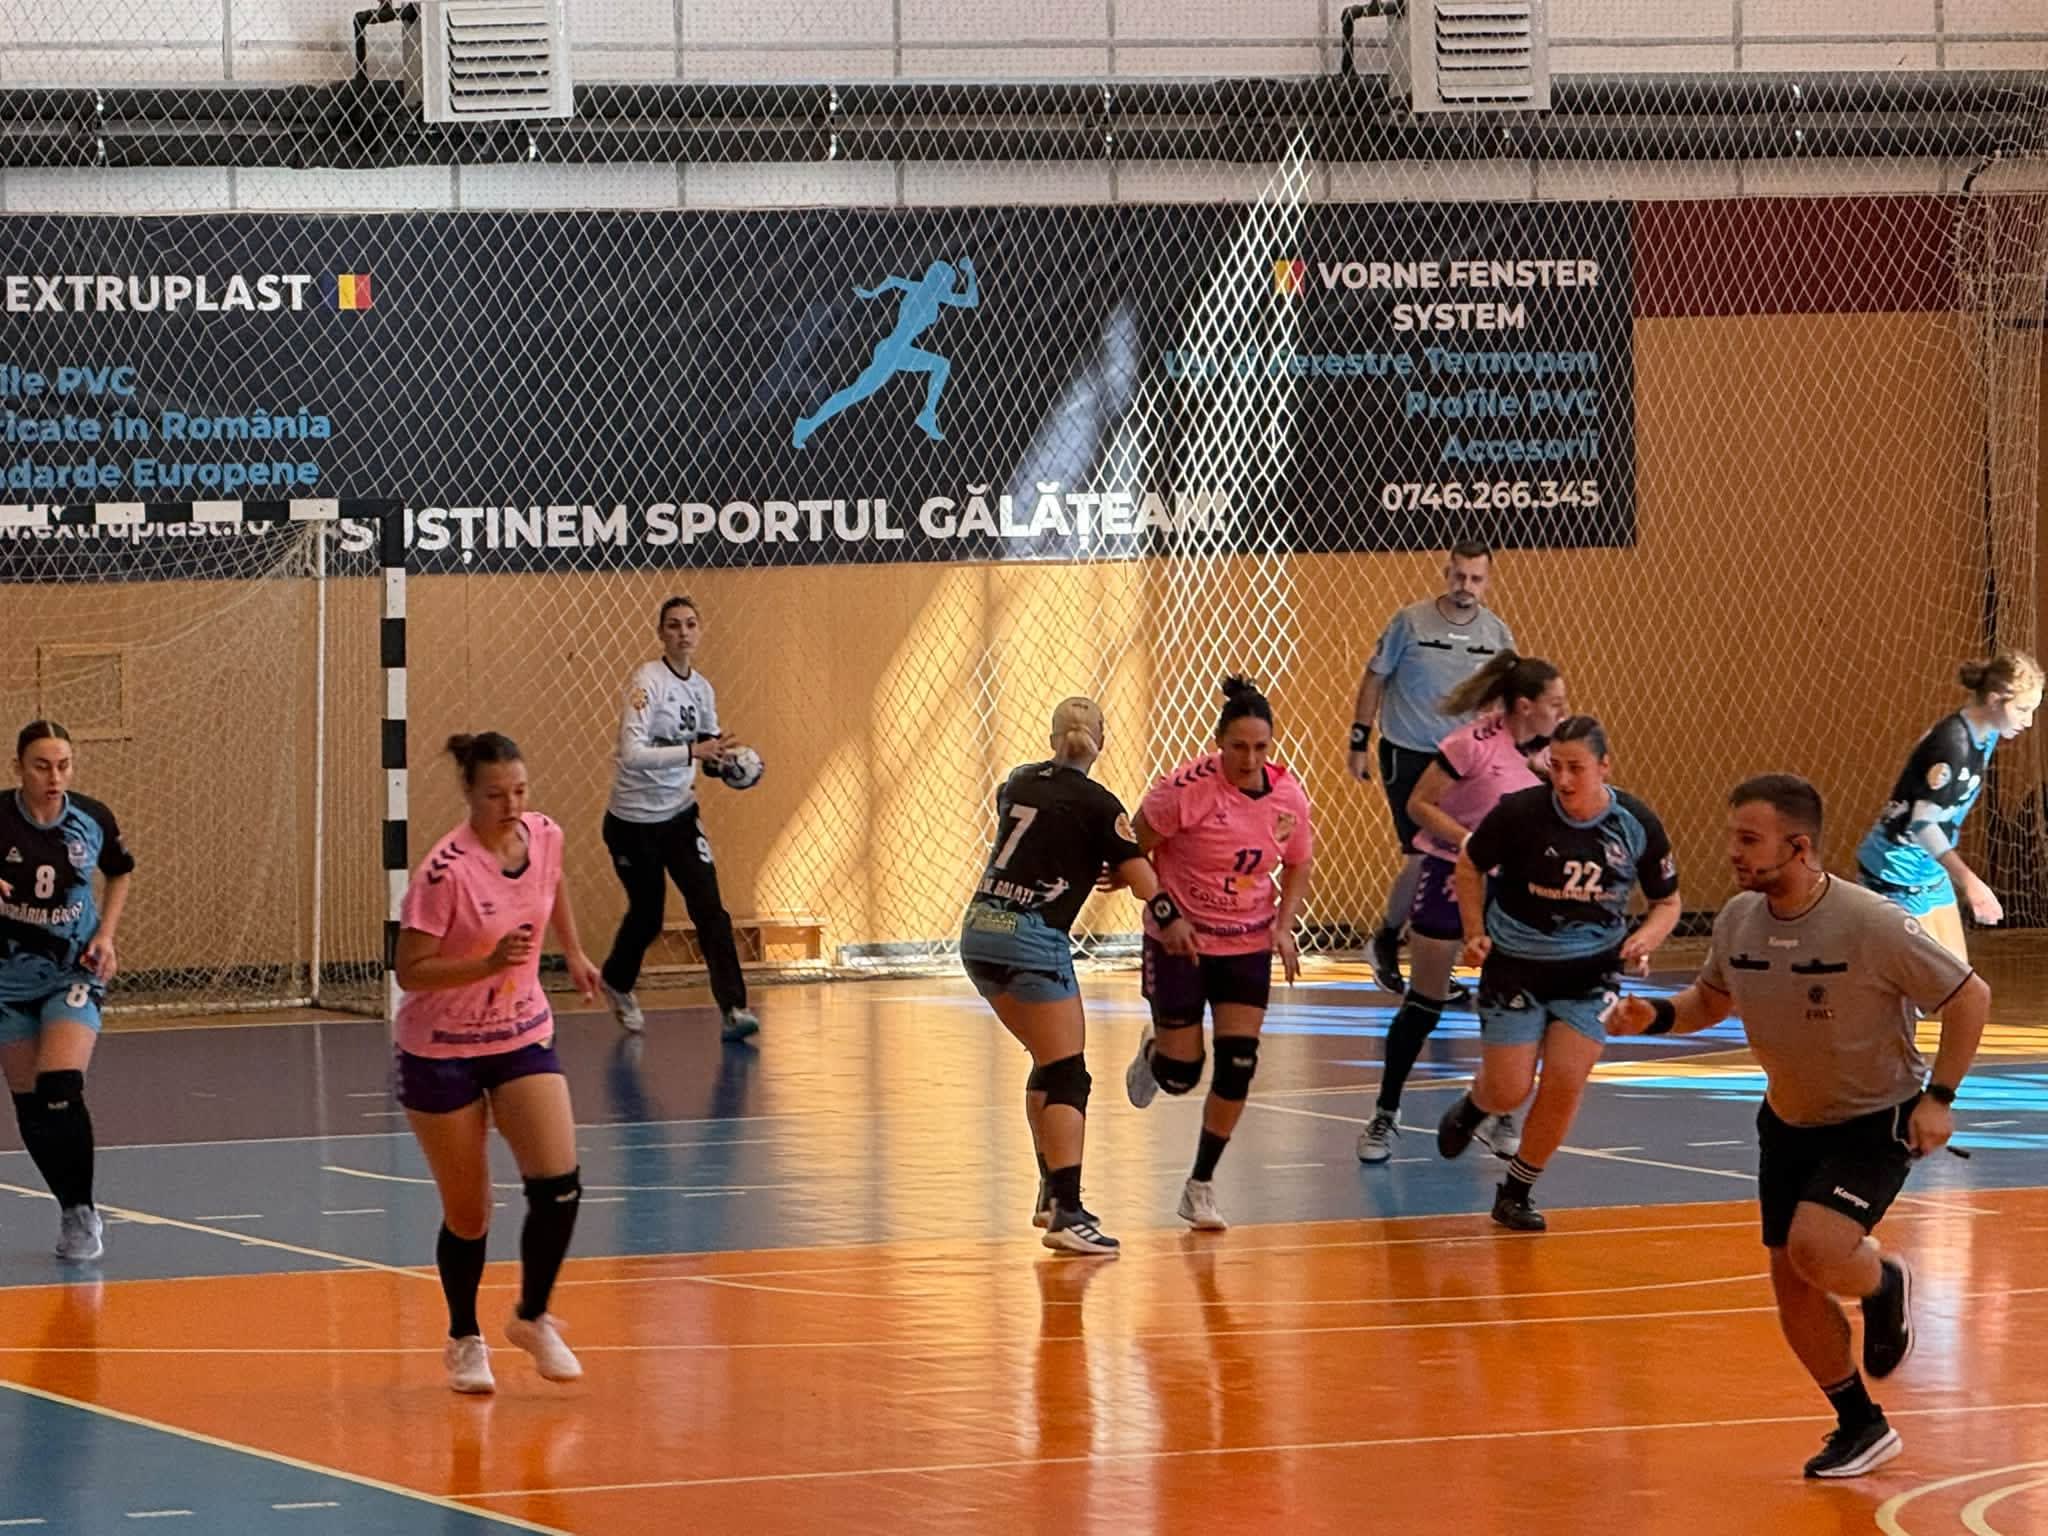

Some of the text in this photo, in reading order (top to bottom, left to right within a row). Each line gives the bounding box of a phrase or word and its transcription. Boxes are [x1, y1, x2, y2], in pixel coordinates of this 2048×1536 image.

[1318, 259, 1599, 289] VORNE FENSTER
[5, 274, 311, 312] EXTRUPLAST
[1392, 303, 1526, 331] SYSTEM
[1424, 346, 1599, 380] Termopan
[57, 366, 136, 397] PVC
[1405, 387, 1599, 418] Profile PVC
[0, 408, 331, 442] icate în România
[1442, 429, 1599, 463] Accesorii
[133, 457, 319, 492] Europene
[1381, 479, 1599, 512] 0746.266.345
[645, 498, 904, 546] SPORTUL
[994, 803, 1039, 870] 7
[1233, 847, 1263, 876] 17
[1562, 860, 1603, 893] 22
[34, 864, 56, 899] 8
[65, 982, 91, 1009] 8
